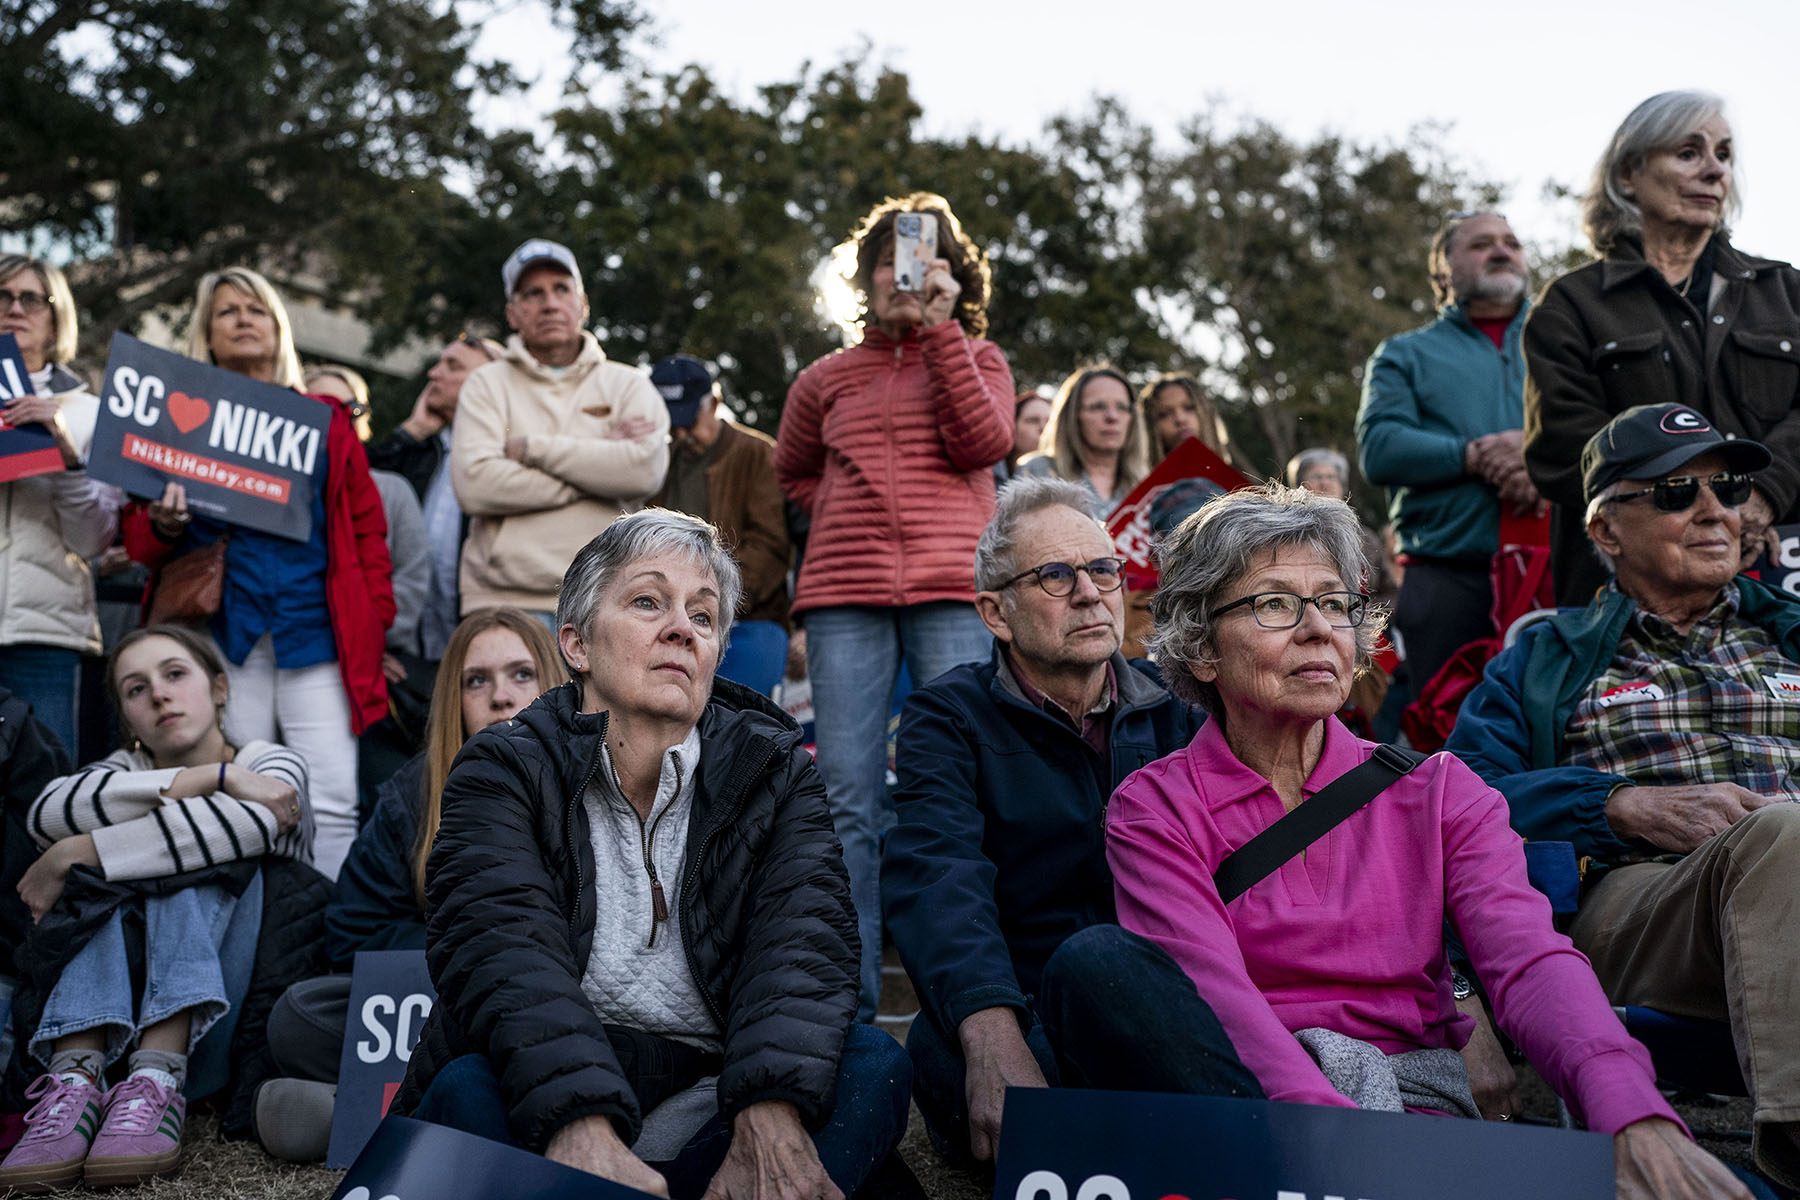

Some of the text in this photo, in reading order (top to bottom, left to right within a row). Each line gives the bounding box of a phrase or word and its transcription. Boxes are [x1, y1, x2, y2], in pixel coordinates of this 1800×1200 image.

[108, 366, 321, 475] SC NIKKI
[131, 439, 283, 498] NikkiHaley.com
[357, 994, 433, 1064] SC
